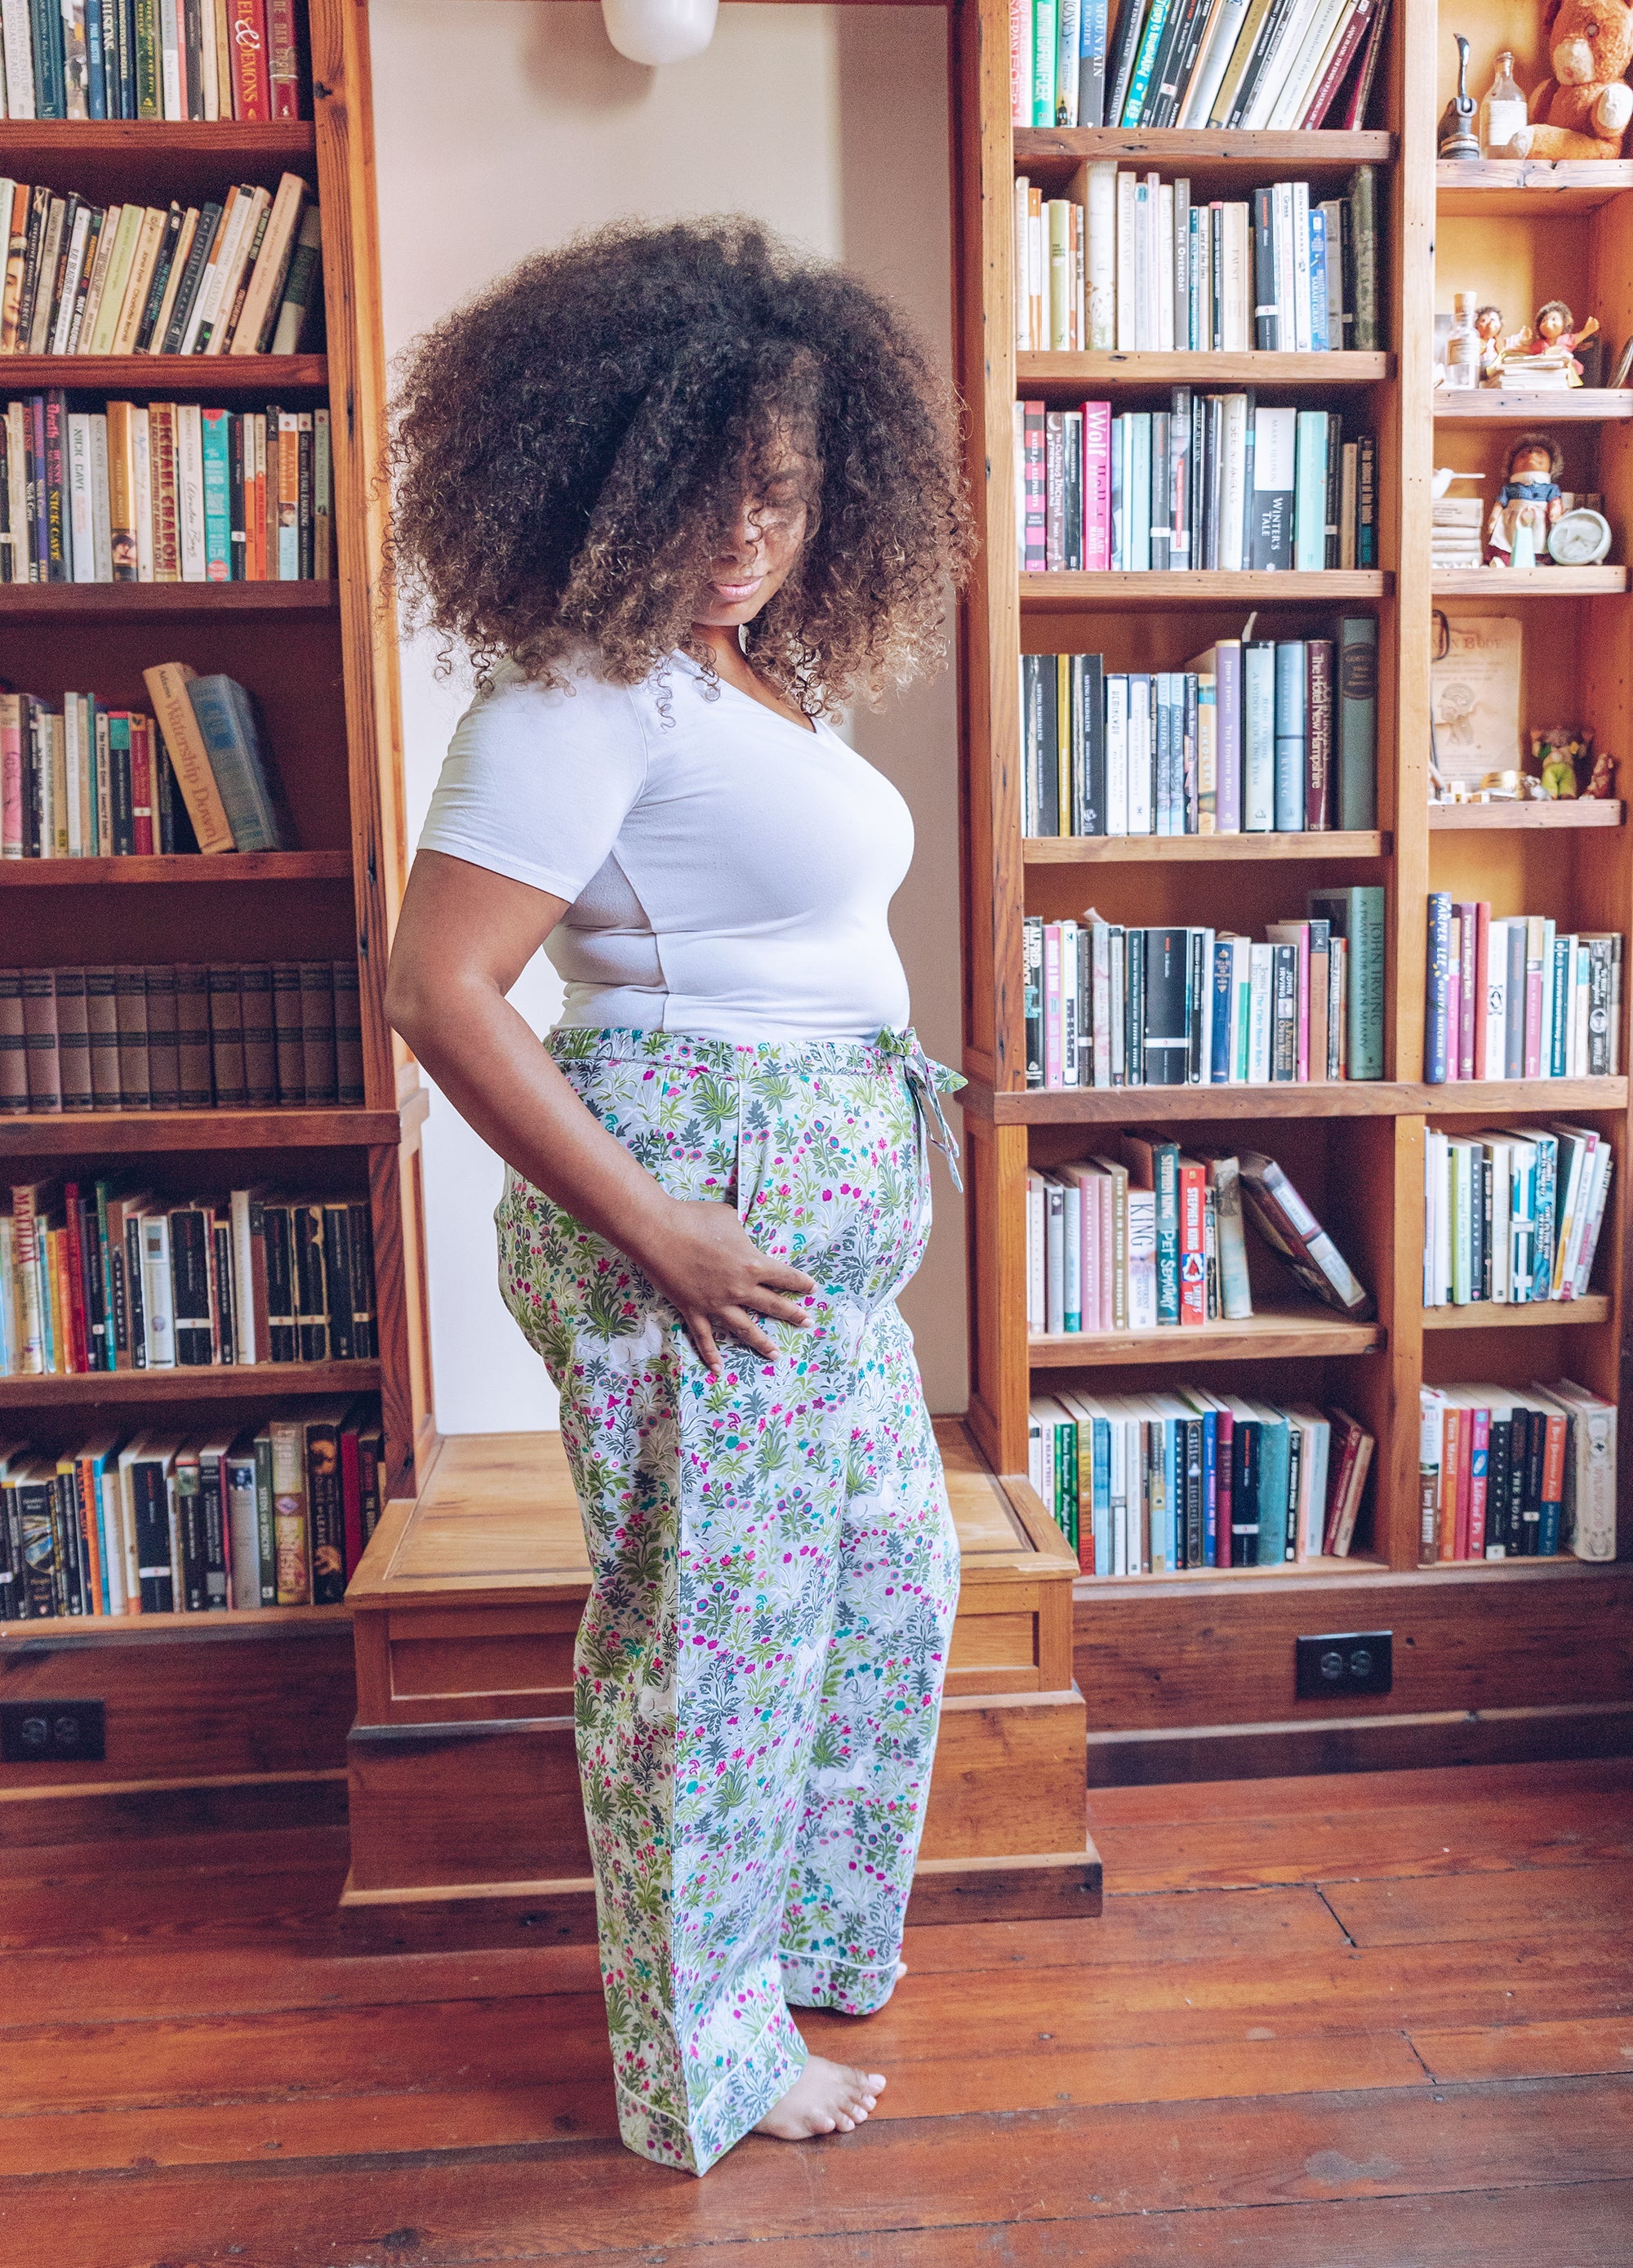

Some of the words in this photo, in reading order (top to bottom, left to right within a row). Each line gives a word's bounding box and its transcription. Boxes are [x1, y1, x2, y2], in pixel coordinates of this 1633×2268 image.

[90, 23, 99, 38] PAUL
[1093, 2, 1104, 77] MOUNTAIN
[239, 42, 258, 102] DEMONS
[74, 429, 84, 457] NICK
[1030, 431, 1039, 455] WATER
[1088, 410, 1106, 457] Wolf
[159, 412, 174, 492] MICHAEL
[1229, 467, 1238, 504] ANGELS
[50, 491, 60, 524] NICK
[1261, 511, 1271, 536] TALE
[1271, 497, 1284, 550] WINTER'S
[51, 527, 61, 560] CAVE
[161, 496, 175, 569] CHABON
[1097, 528, 1105, 554] HILARY
[1224, 661, 1233, 682] JOHN
[1312, 655, 1324, 674] The
[1225, 686, 1233, 714] IRVING
[1312, 675, 1324, 703] Hotel
[1225, 725, 1233, 740] THE
[1312, 705, 1324, 729] New
[165, 698, 200, 783] Watership
[194, 788, 216, 839] Down
[1225, 744, 1233, 773] FOURTH
[1281, 751, 1289, 797] IRVING
[1310, 731, 1324, 788] Hampshire
[1225, 778, 1233, 801] HAND
[1438, 897, 1448, 942] HARPER
[1030, 926, 1041, 968] ALFRED
[1370, 922, 1382, 964] JOHN
[1438, 947, 1448, 966] LEE
[1370, 970, 1382, 1025] IRVING
[1161, 1155, 1174, 1193] STEPHEN
[1162, 1195, 1174, 1219] KING
[1186, 1187, 1199, 1226] STEPHEN
[1130, 1204, 1154, 1246] KING
[1187, 1228, 1199, 1250] KING
[1473, 1482, 1484, 1504] Life
[1513, 1471, 1522, 1494] THE
